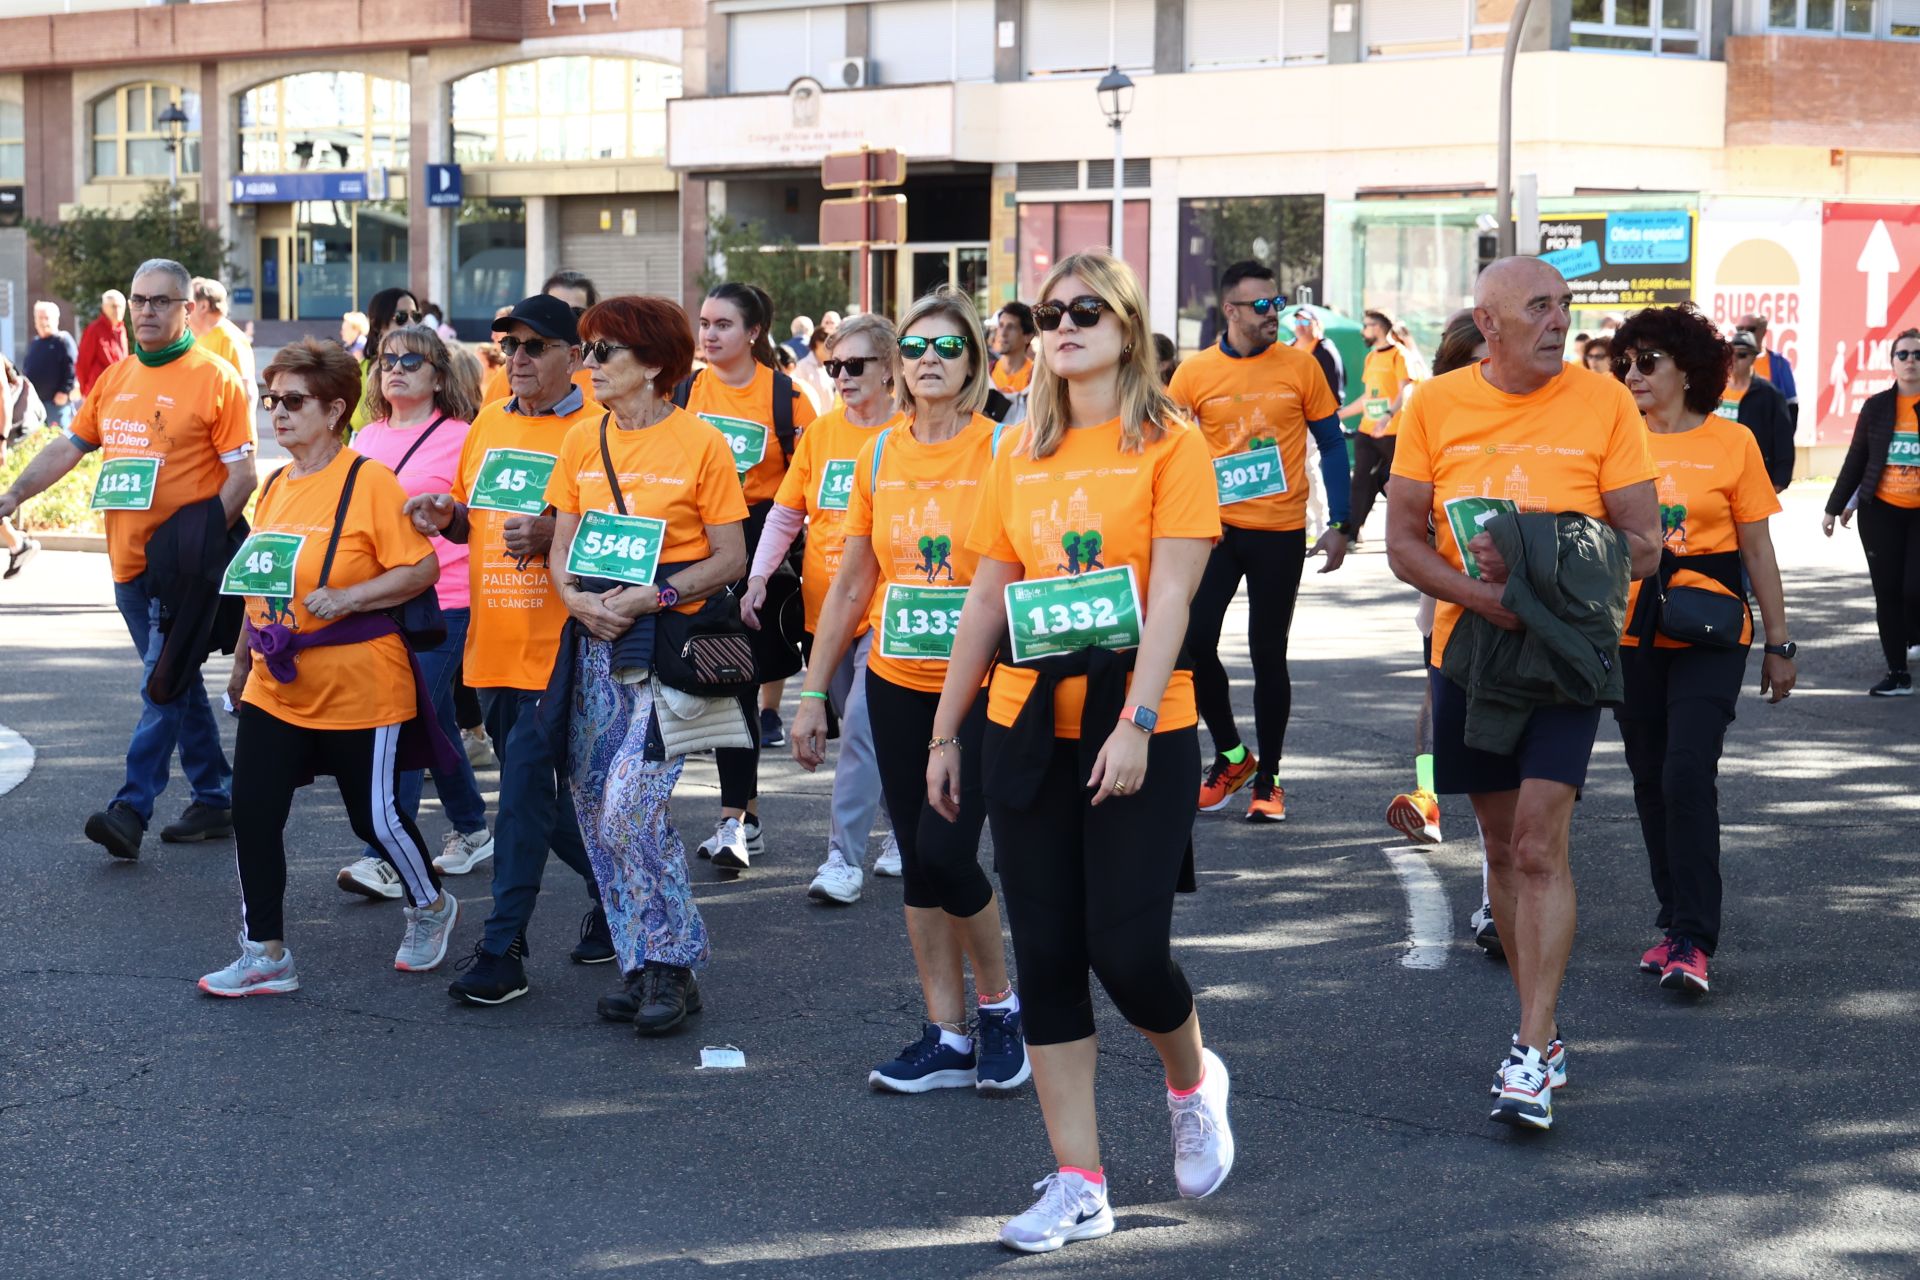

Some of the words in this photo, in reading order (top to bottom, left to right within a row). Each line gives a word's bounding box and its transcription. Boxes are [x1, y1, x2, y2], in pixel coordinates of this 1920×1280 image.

[1540, 223, 1582, 240] Parking
[1714, 293, 1799, 324] BURGER
[103, 419, 110, 430] El
[112, 419, 146, 433] Cristo
[117, 433, 149, 447] Otero
[101, 473, 141, 492] 1121
[495, 468, 528, 491] 45
[1220, 462, 1272, 489] 3017
[583, 530, 648, 561] 5546
[245, 551, 273, 574] 46
[482, 573, 549, 586] PALENCIA
[487, 598, 499, 608] EL
[500, 596, 544, 608] CÁNCER
[1028, 597, 1118, 636] 1332
